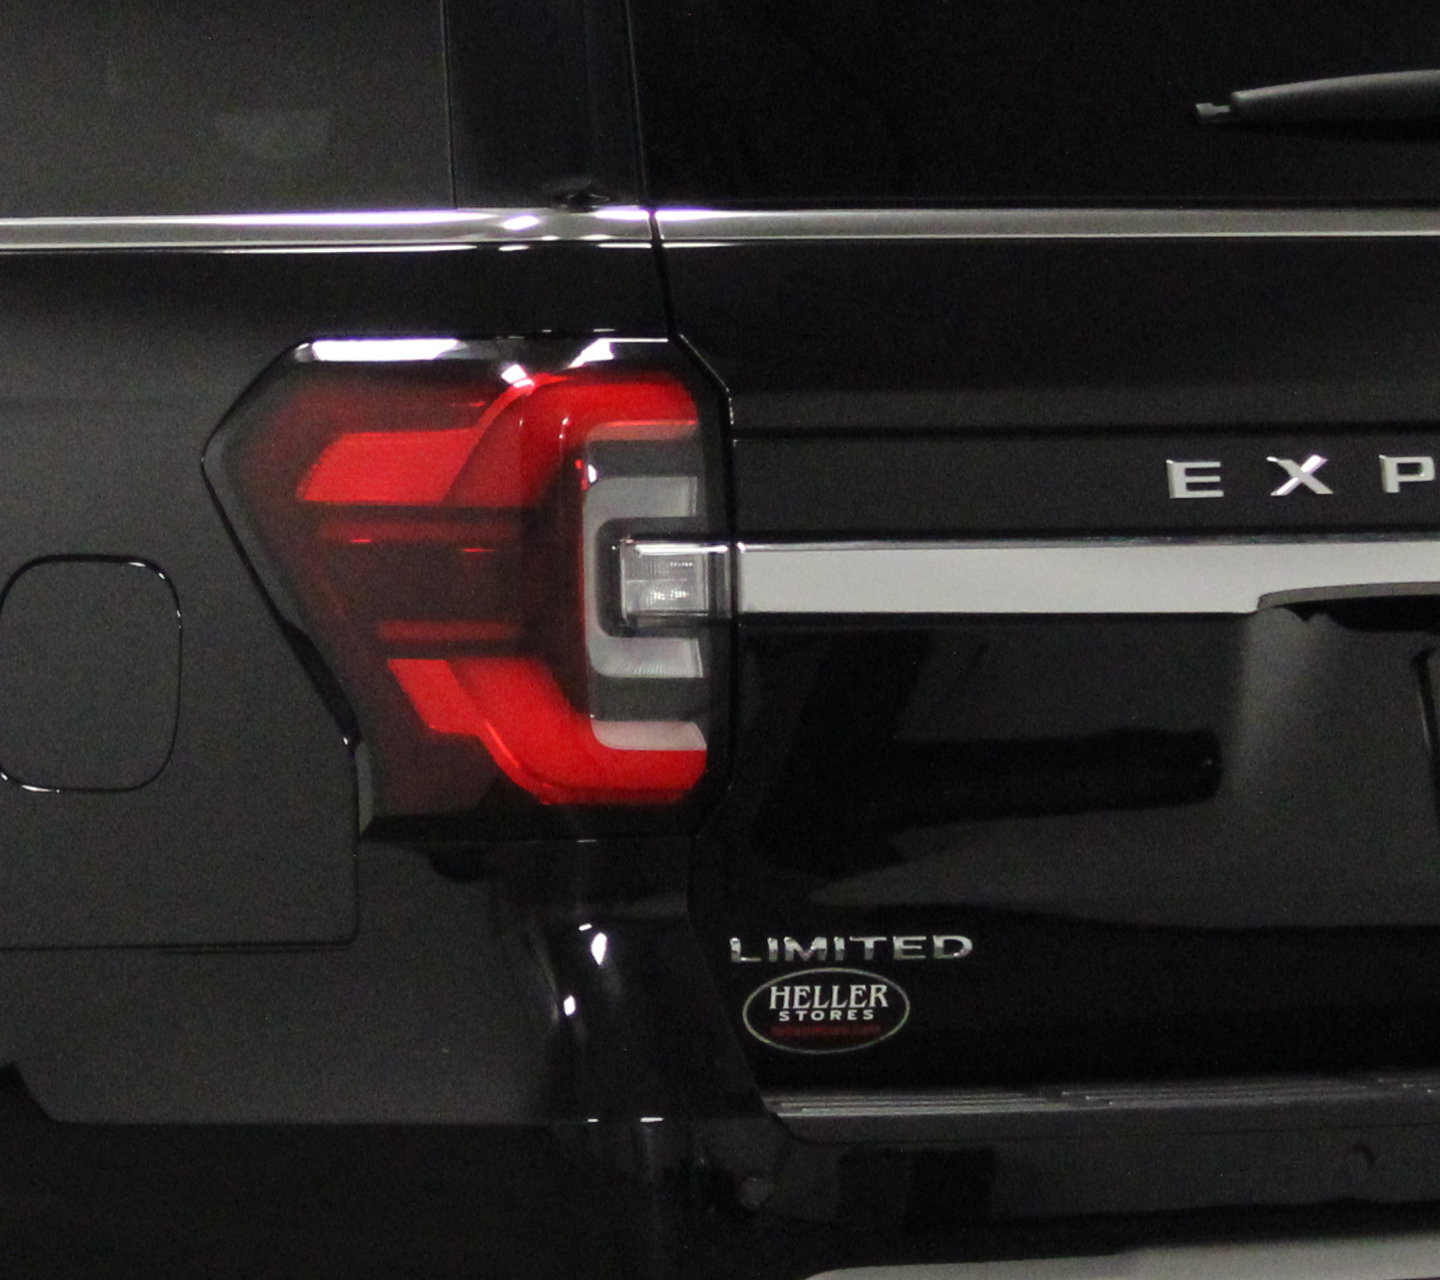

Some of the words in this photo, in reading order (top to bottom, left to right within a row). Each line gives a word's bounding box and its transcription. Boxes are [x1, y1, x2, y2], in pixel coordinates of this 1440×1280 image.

[729, 934, 974, 963] LIMITED
[769, 984, 889, 1010] HELLER
[778, 1009, 875, 1022] STORES
